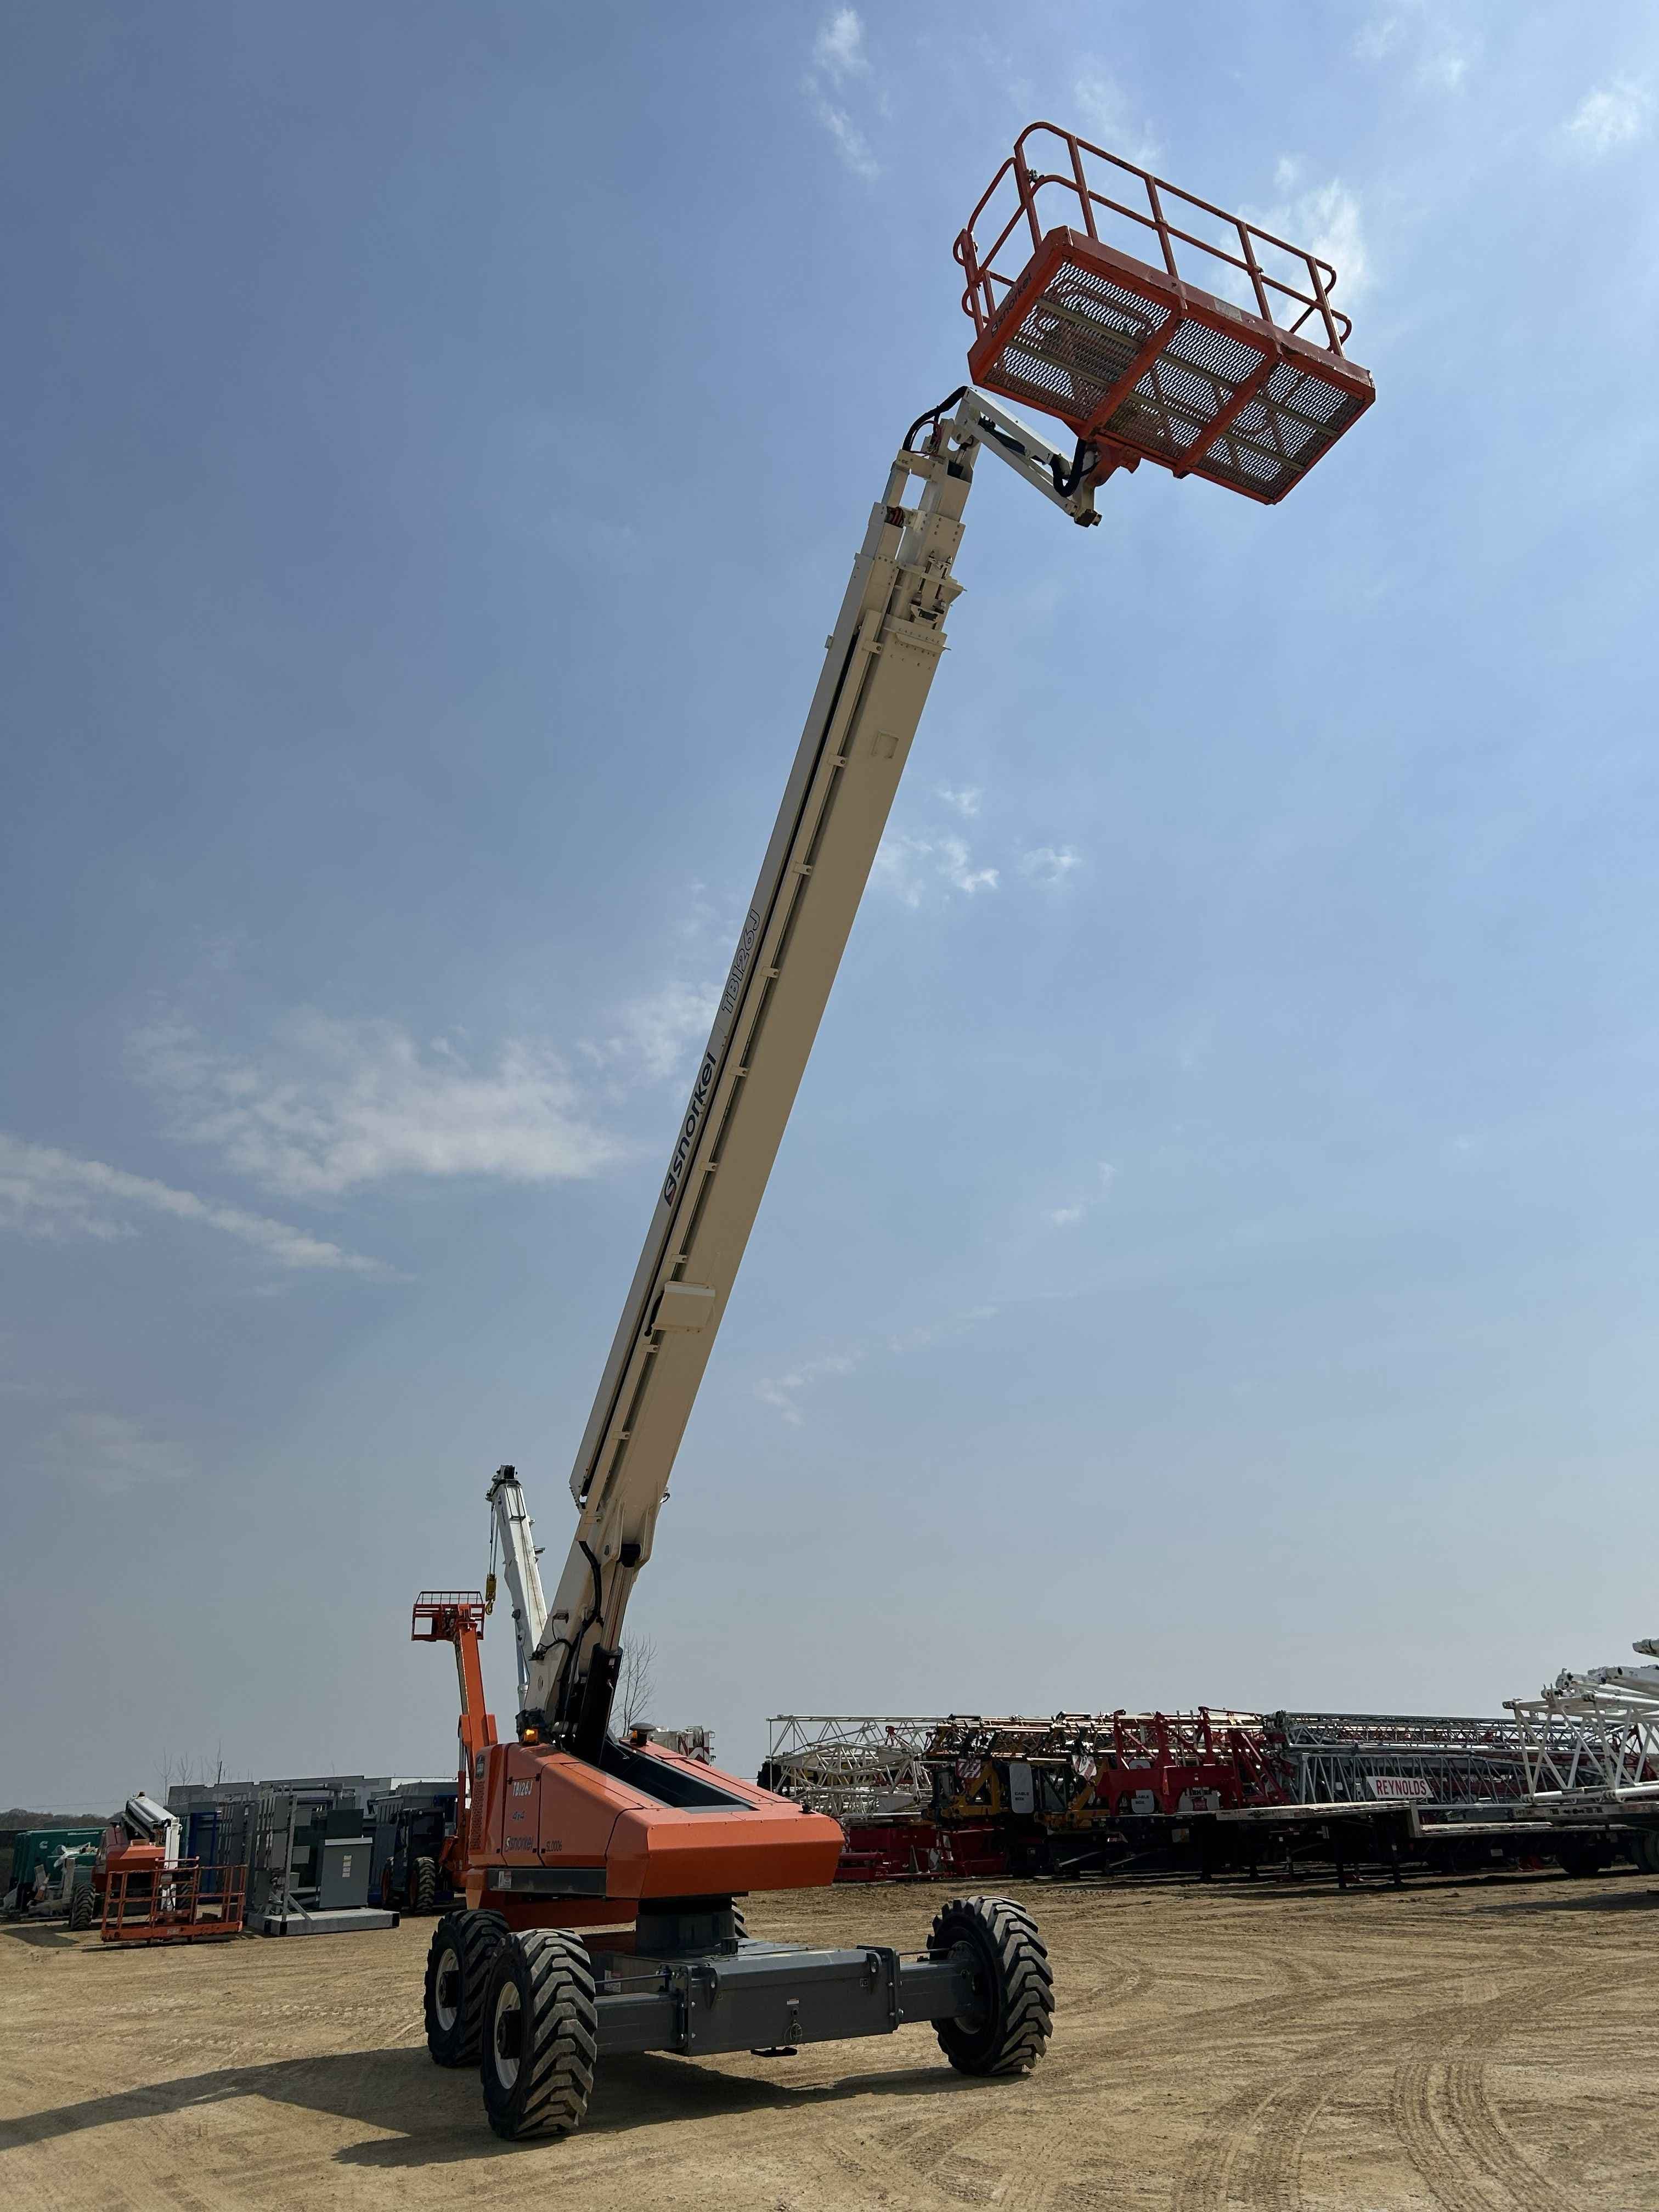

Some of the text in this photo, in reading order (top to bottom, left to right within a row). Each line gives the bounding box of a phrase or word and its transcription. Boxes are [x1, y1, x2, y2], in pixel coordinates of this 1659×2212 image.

[721, 909, 760, 1014] TB126J
[673, 1052, 716, 1178] snorkel
[512, 1781, 533, 1797] TB126J
[1376, 1779, 1426, 1795] REYNOLDS
